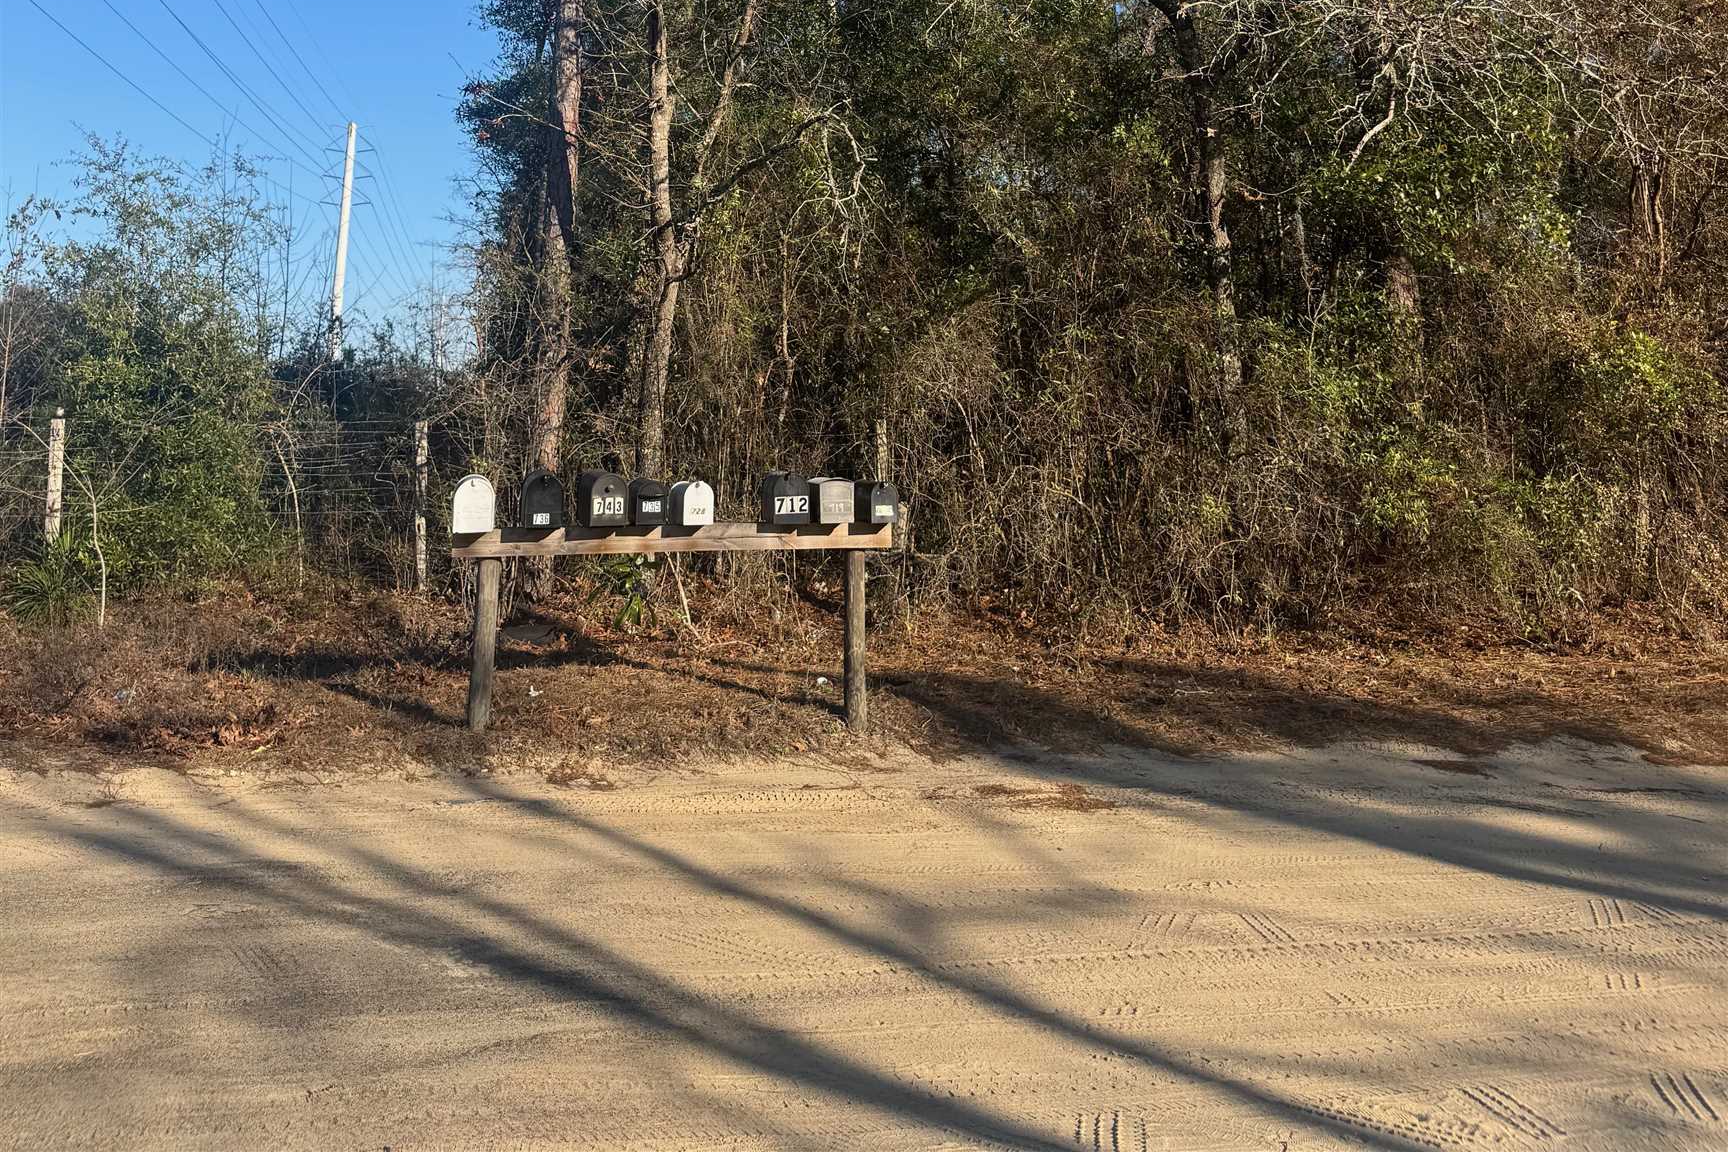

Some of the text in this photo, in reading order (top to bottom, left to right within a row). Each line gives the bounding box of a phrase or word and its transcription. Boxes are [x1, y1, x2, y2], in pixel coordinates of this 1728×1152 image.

[596, 501, 622, 513] 743
[776, 497, 808, 513] 712
[534, 514, 549, 524] 736
